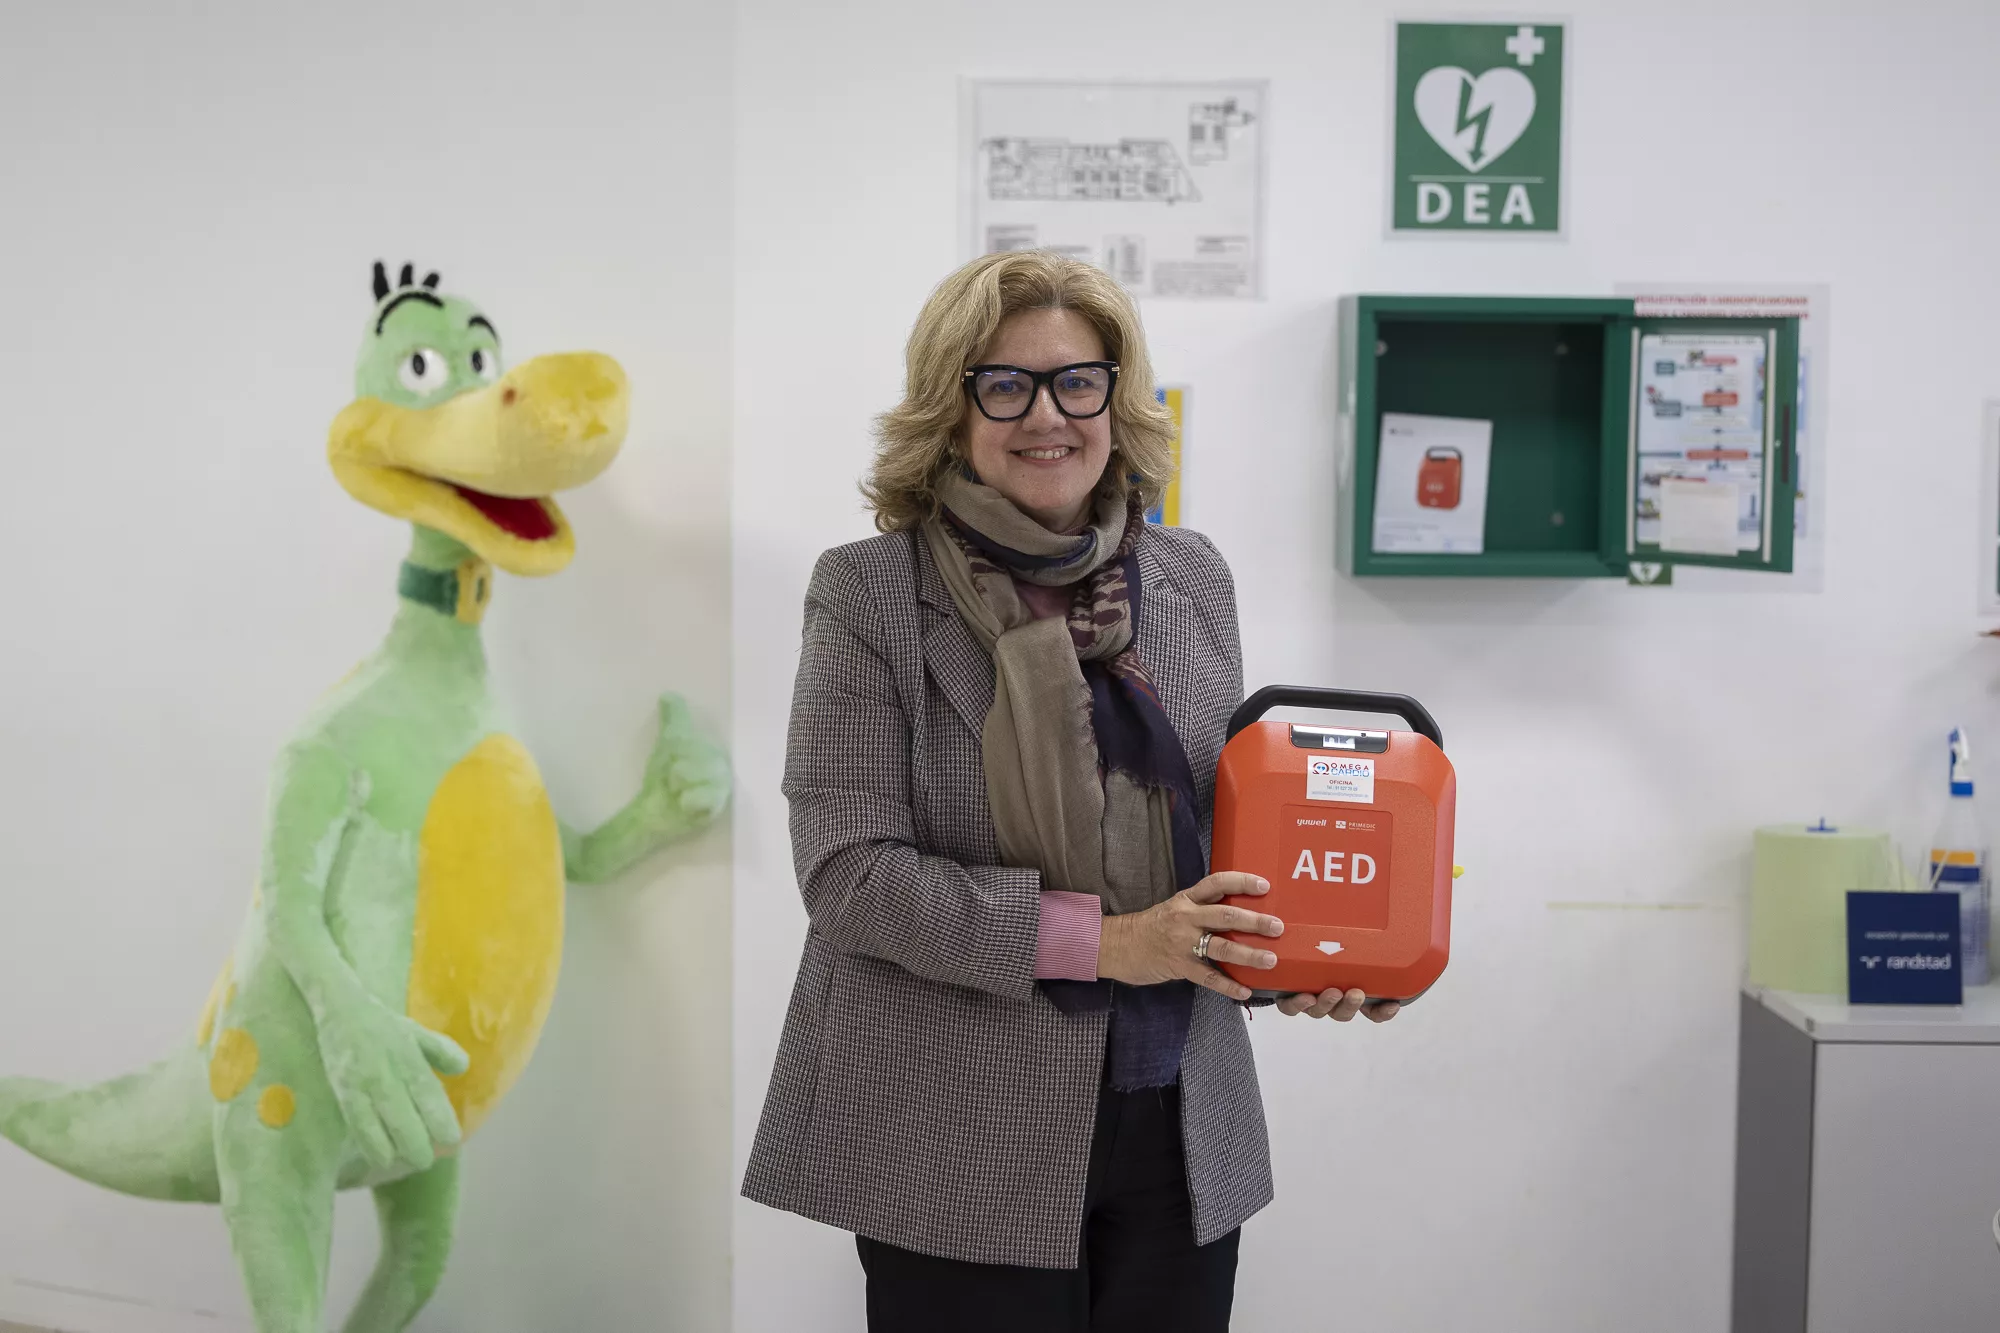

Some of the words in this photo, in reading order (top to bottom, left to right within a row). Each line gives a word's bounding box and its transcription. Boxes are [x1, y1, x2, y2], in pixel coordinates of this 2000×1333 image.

[1416, 182, 1535, 225] DEA
[1331, 769, 1369, 777] CARDIO
[1291, 849, 1376, 884] AED
[1887, 953, 1951, 970] randstad
